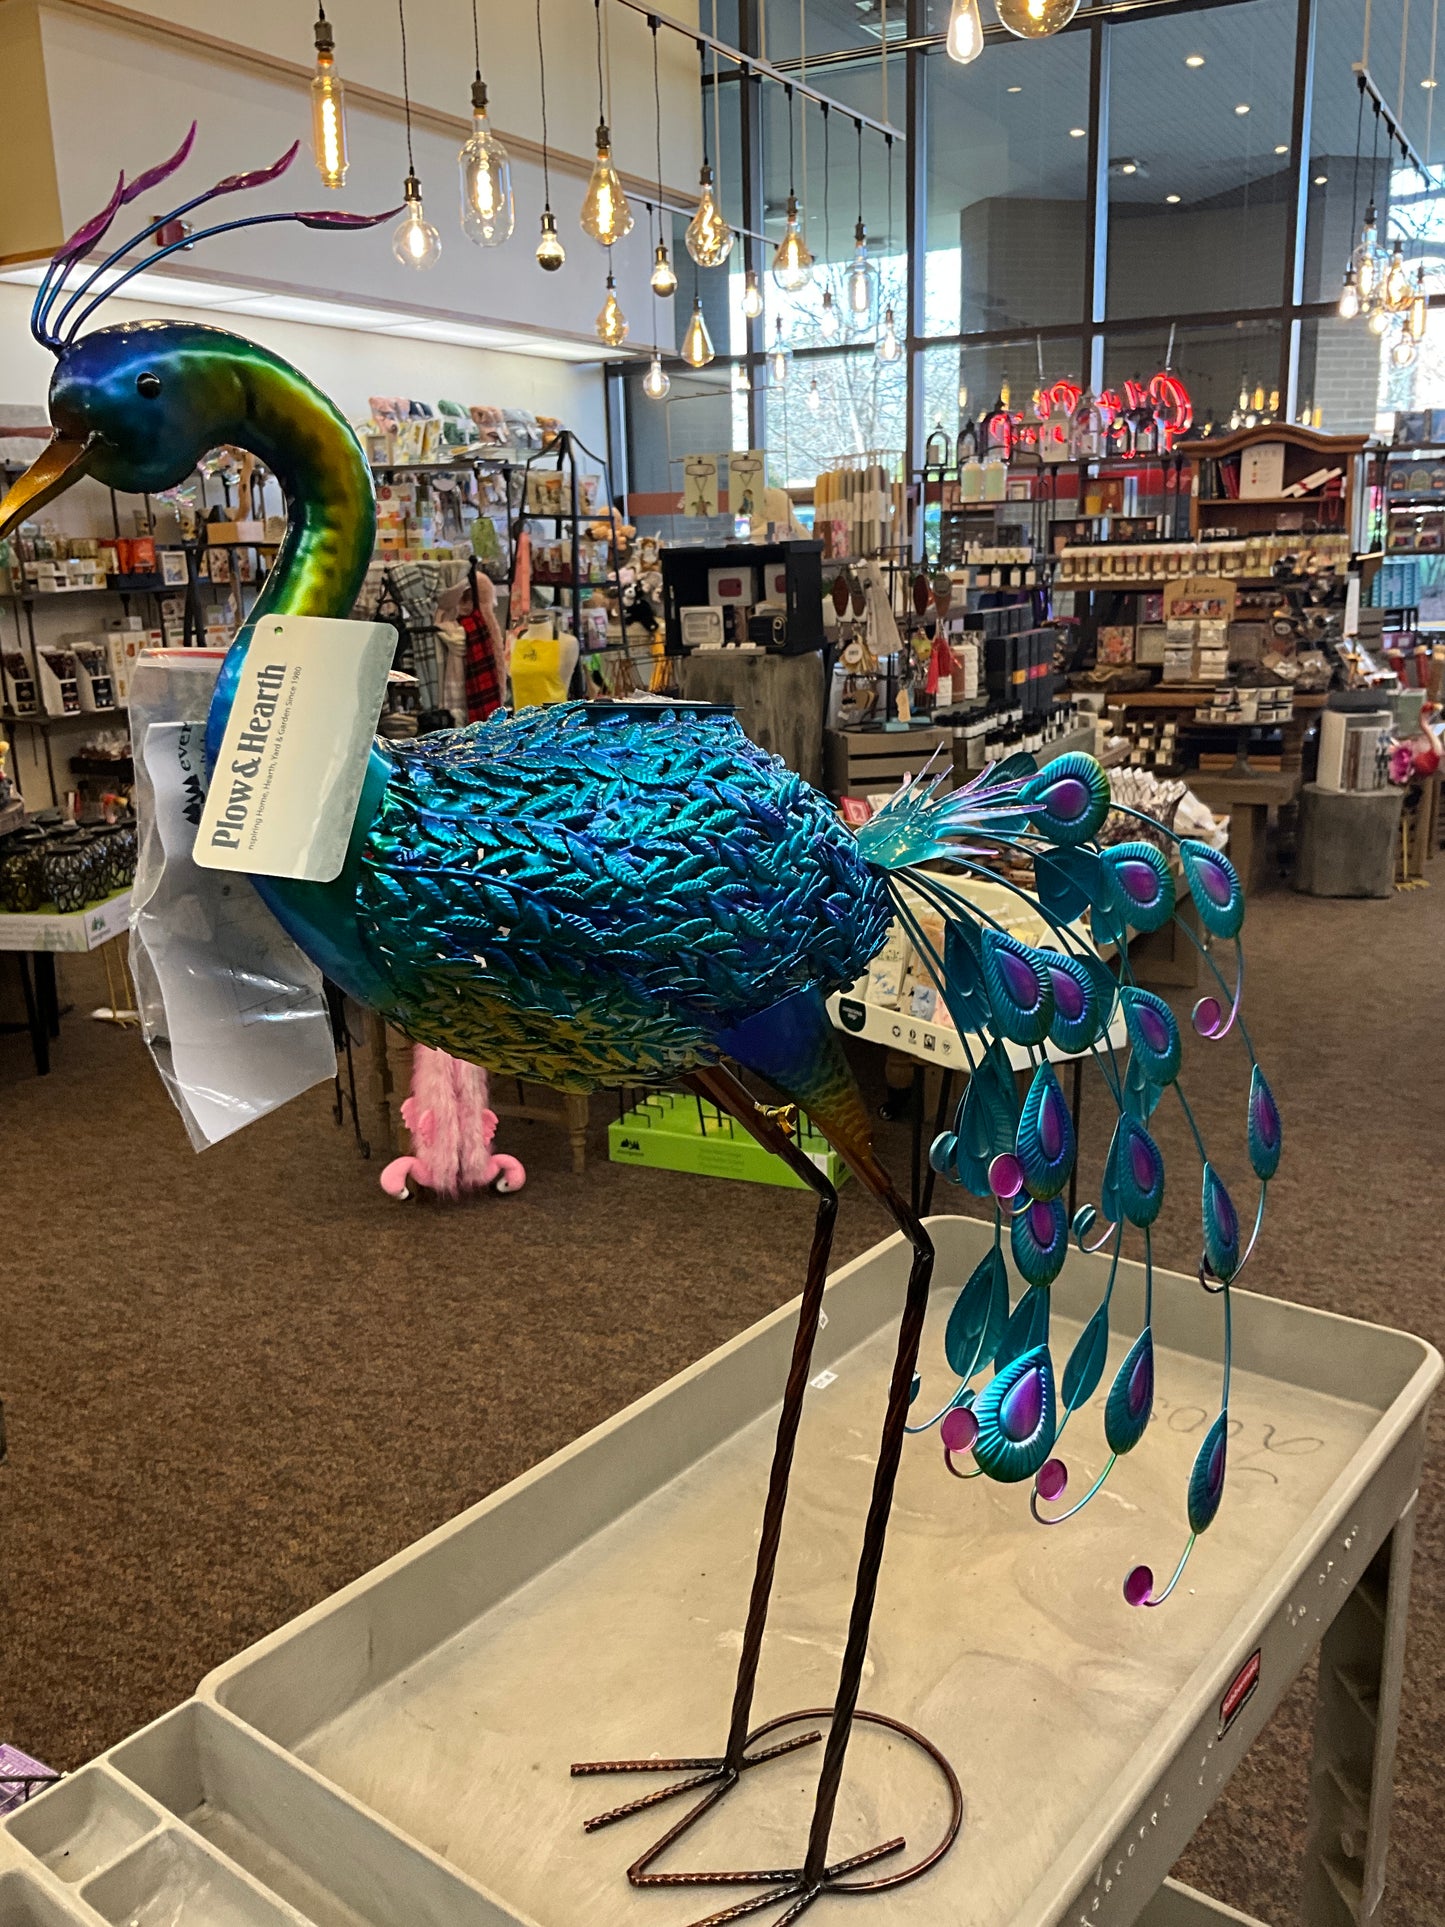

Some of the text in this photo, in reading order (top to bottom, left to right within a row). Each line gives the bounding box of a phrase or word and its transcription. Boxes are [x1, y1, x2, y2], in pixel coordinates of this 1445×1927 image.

[291, 666, 303, 684] 1980
[286, 686, 297, 706] Since
[278, 707, 291, 735] Garden
[211, 664, 287, 850] Plow & Hearth
[271, 743, 281, 760] Yard
[263, 761, 278, 790] Hearth,
[255, 791, 270, 817] Home,
